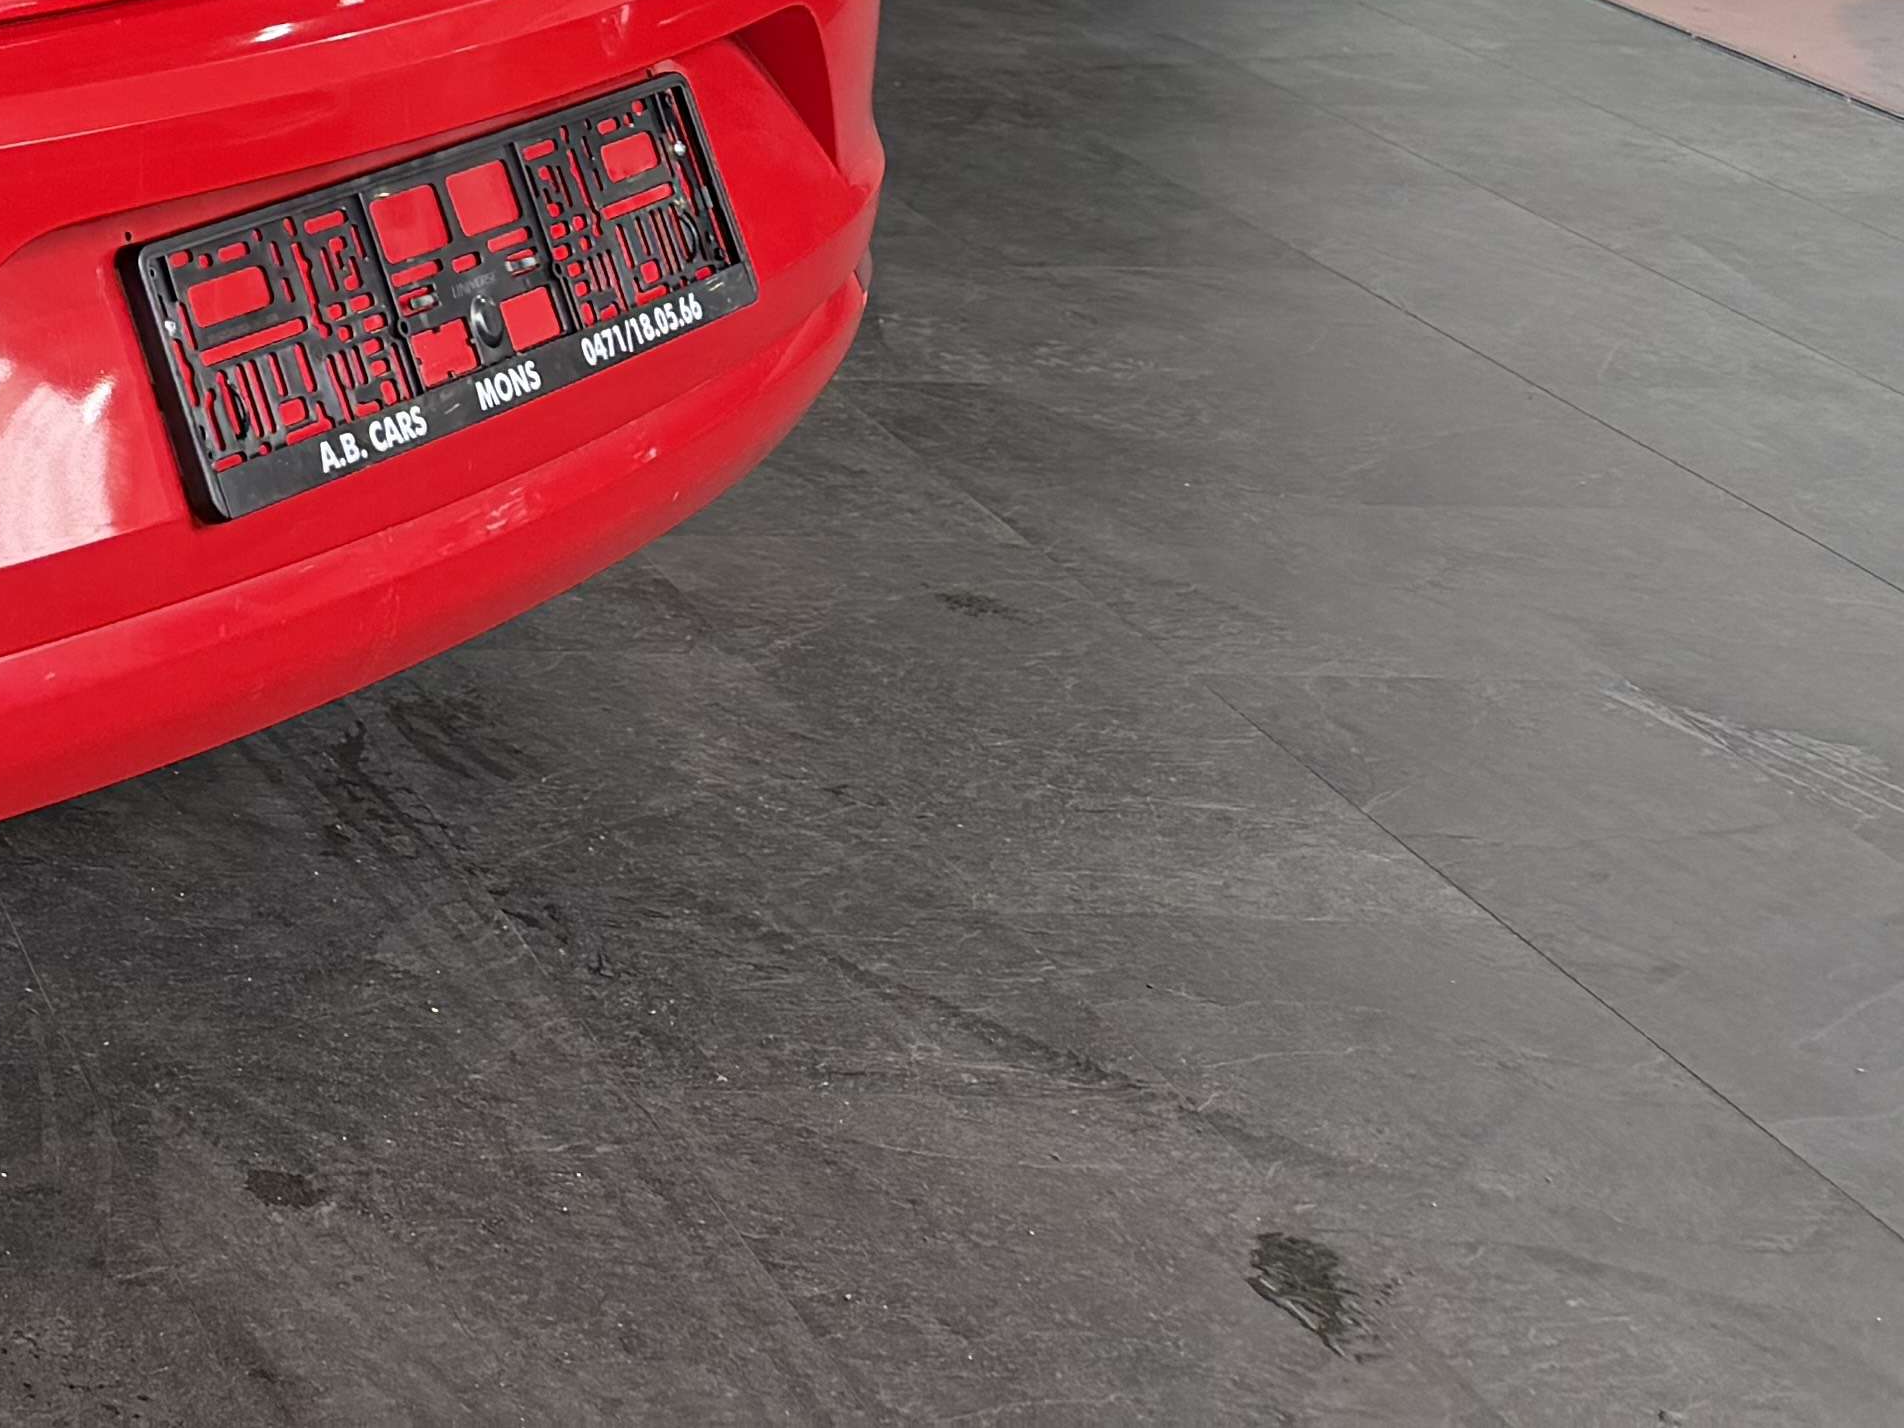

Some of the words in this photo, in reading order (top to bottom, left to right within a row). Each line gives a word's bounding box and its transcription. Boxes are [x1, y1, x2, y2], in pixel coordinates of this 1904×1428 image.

[319, 433, 368, 474] A.B.
[369, 406, 428, 453] CARS
[475, 360, 542, 411] MONS
[581, 293, 704, 366] 0471/18.05.66
